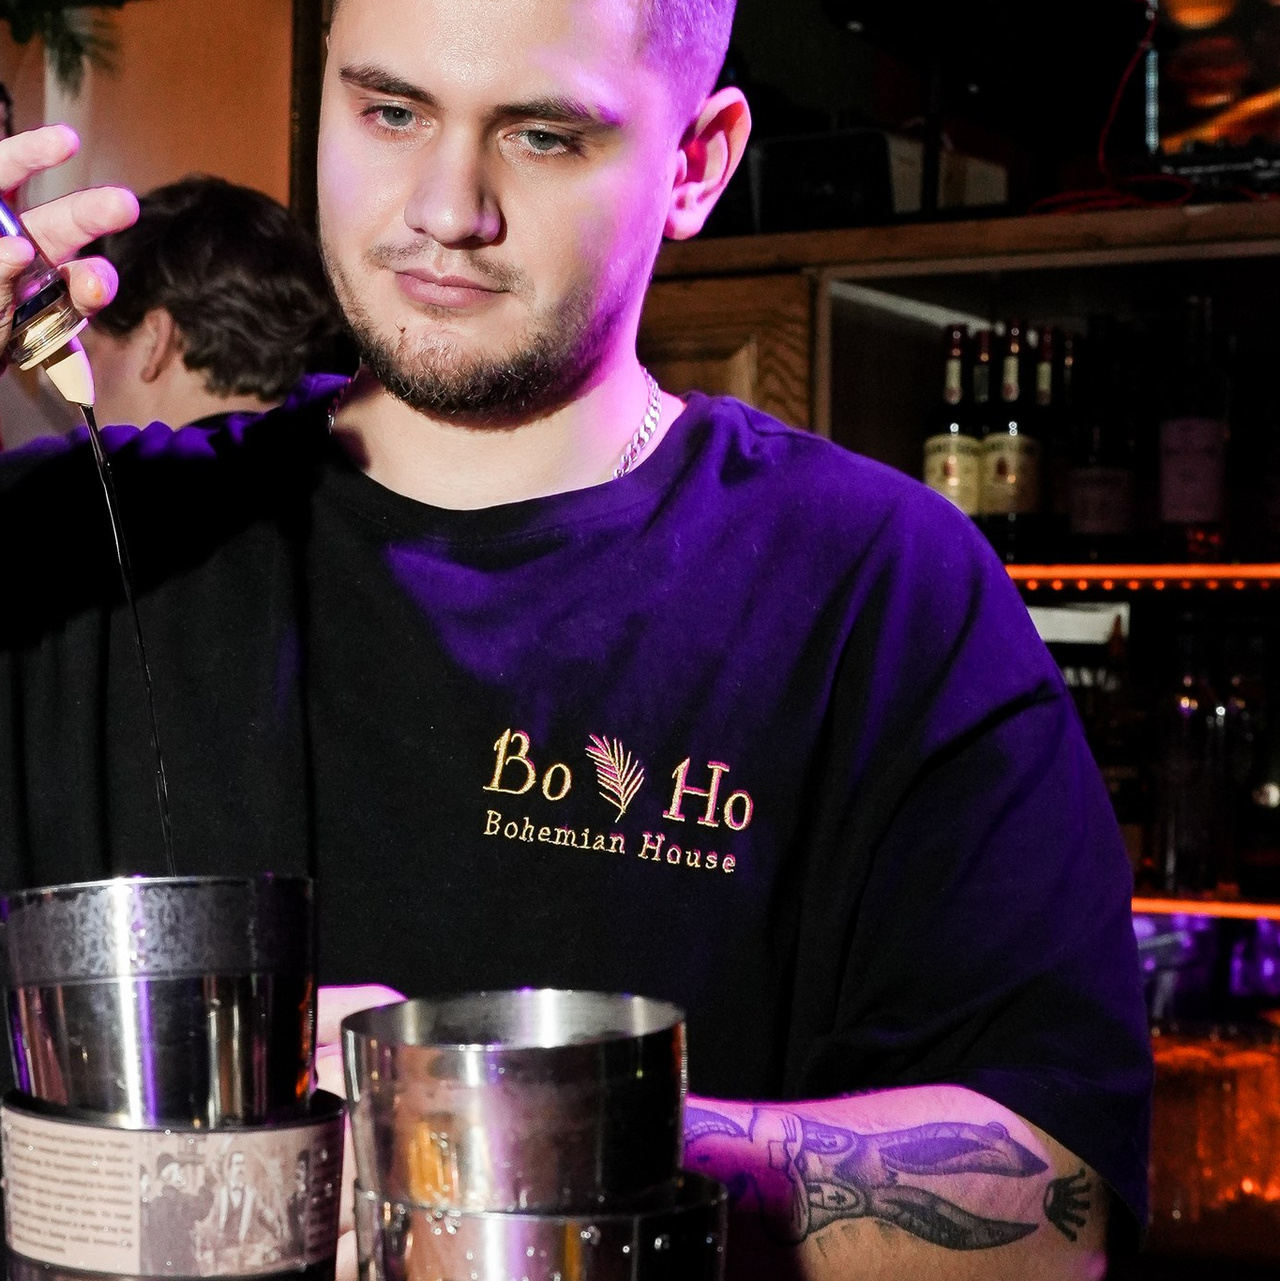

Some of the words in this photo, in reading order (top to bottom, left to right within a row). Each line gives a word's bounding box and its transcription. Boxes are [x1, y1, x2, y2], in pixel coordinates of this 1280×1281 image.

[483, 728, 572, 801] Bo
[662, 756, 754, 832] Ho
[484, 810, 626, 854] Bohemian
[637, 830, 737, 874] House
